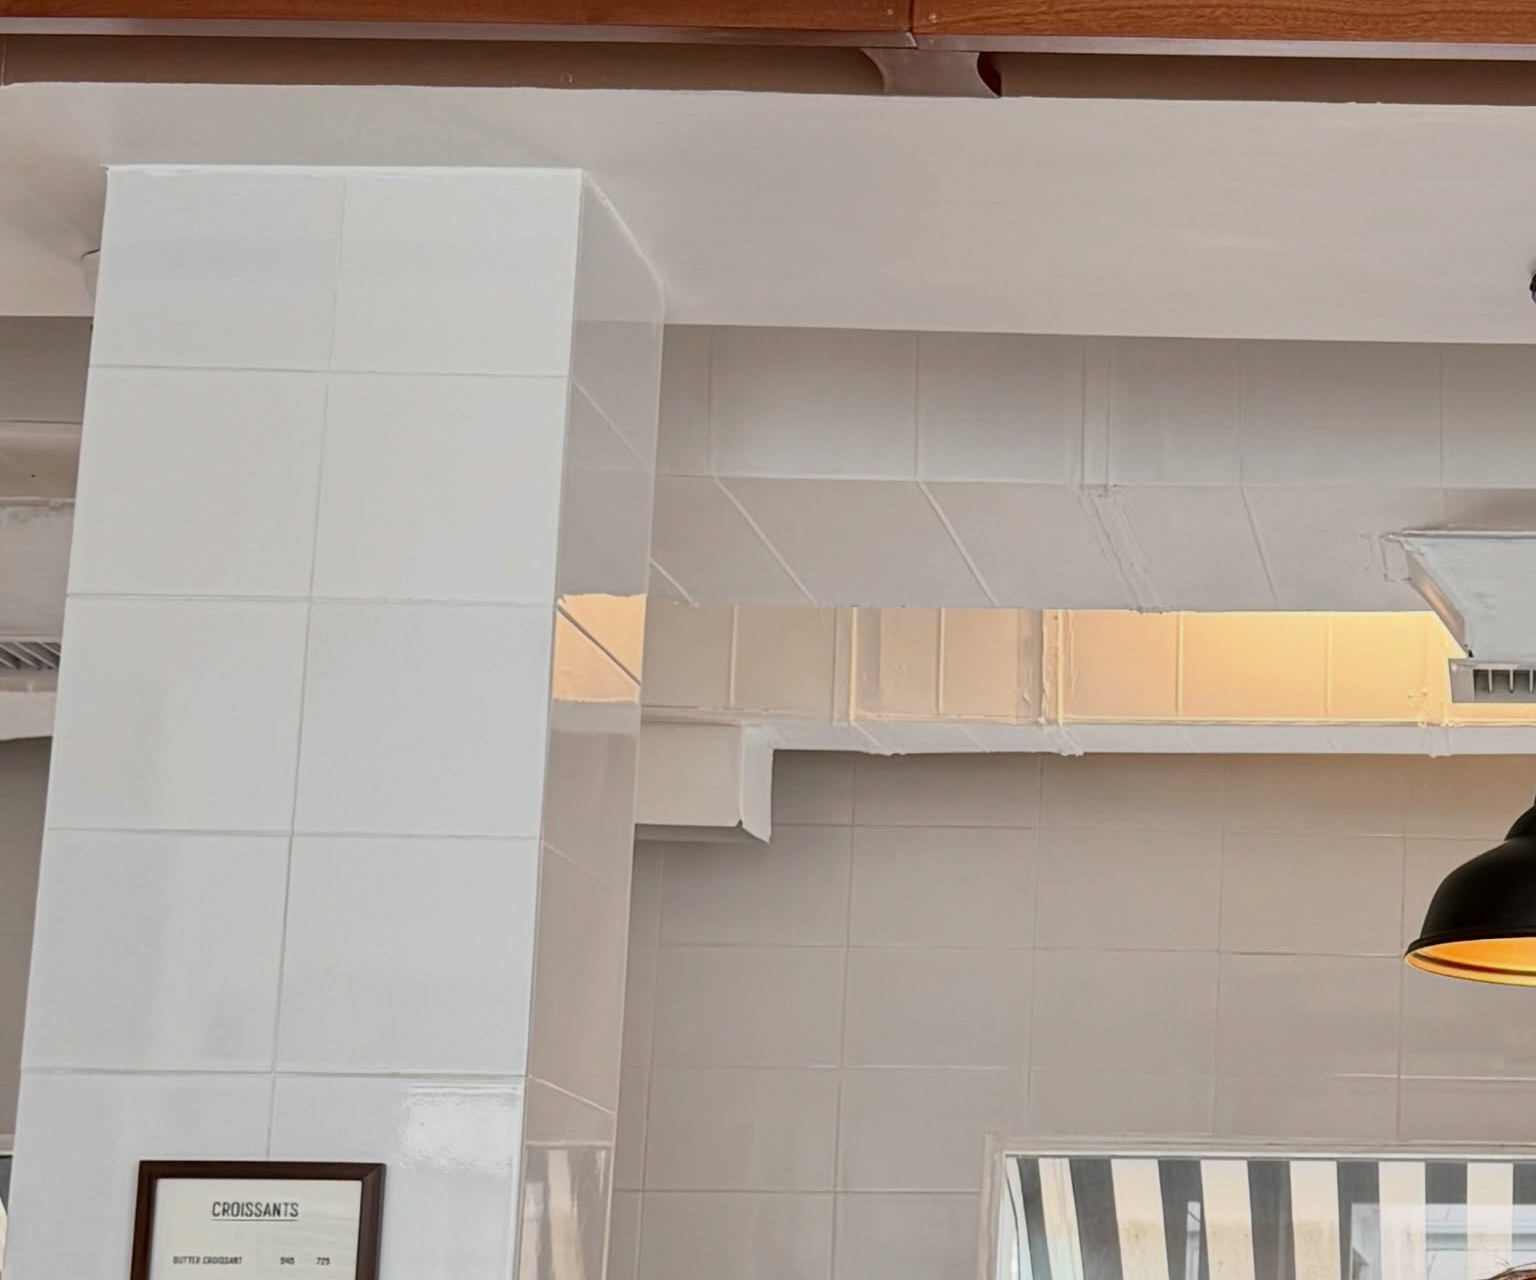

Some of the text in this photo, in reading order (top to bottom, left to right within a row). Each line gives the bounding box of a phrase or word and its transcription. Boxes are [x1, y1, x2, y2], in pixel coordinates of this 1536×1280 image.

[212, 1201, 299, 1217] CROISSANTS
[173, 1256, 200, 1264] BUTTER
[202, 1256, 243, 1264] CROISSANT
